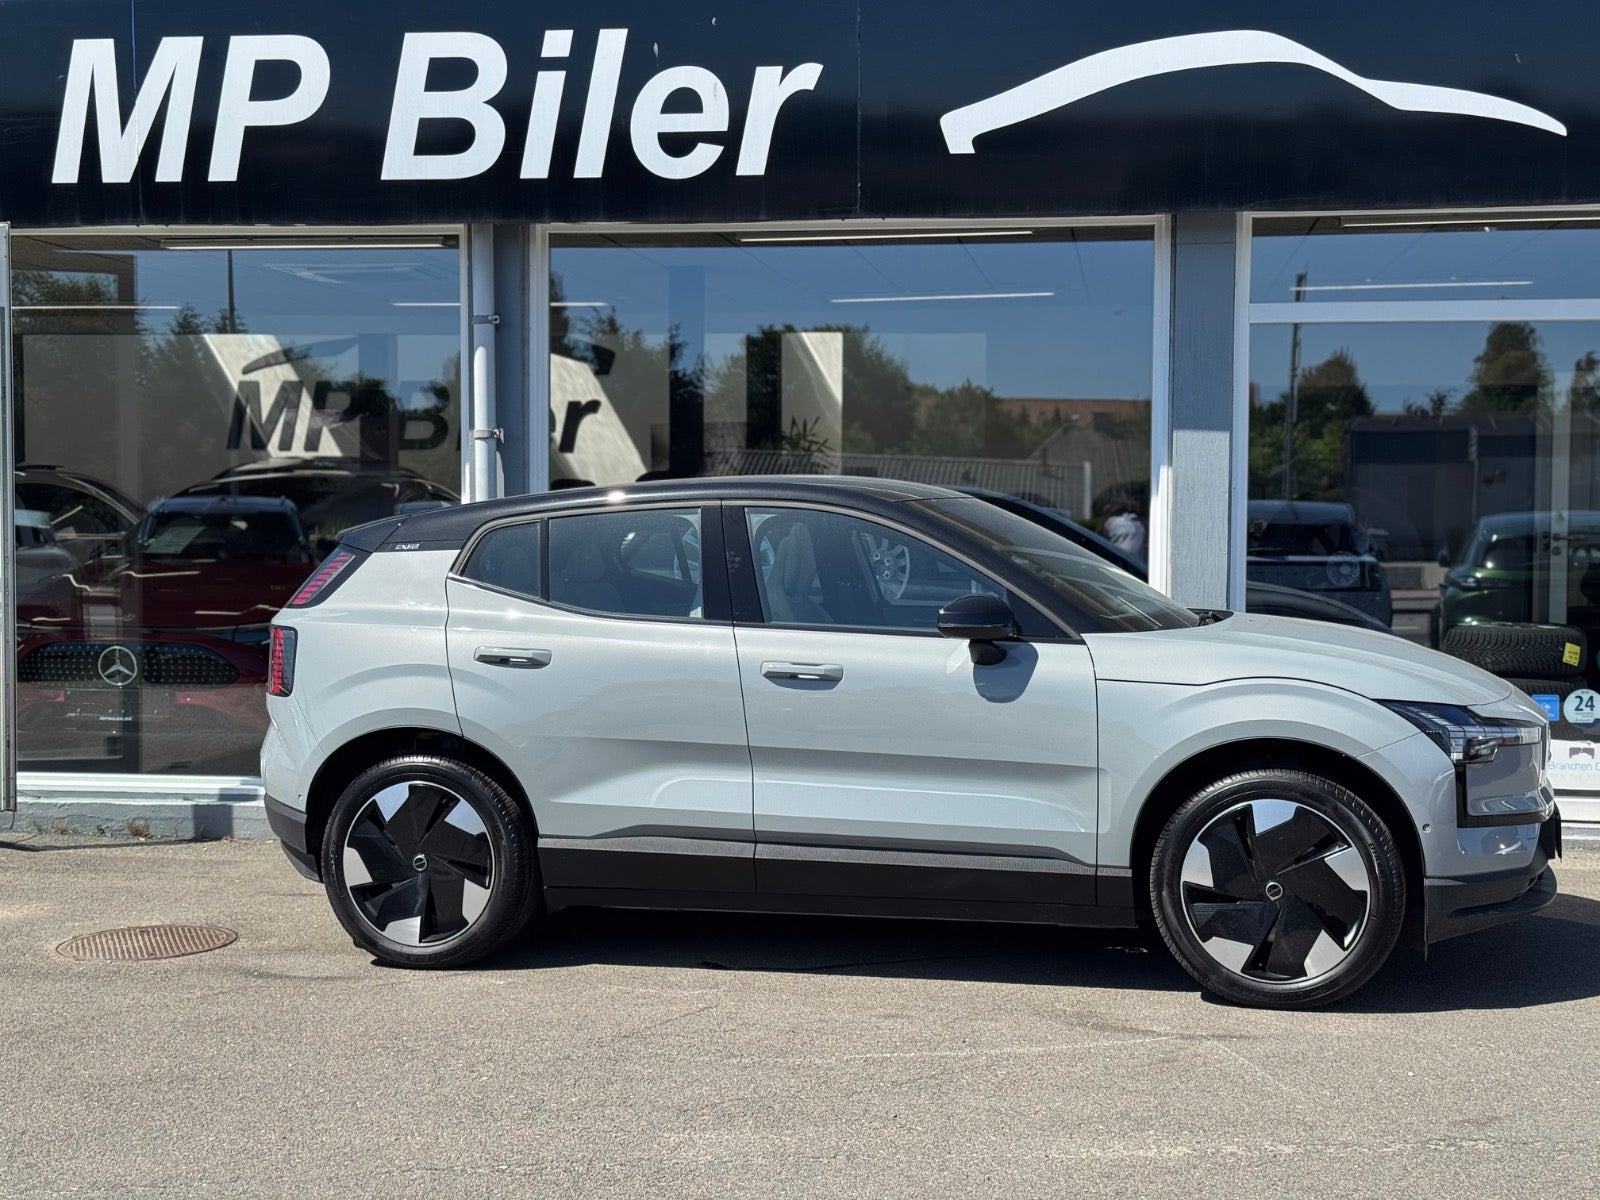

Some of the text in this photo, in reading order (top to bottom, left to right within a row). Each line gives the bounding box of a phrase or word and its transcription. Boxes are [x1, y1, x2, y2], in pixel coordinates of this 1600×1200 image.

[52, 29, 823, 183] MP Biler
[226, 381, 352, 452] MP
[1574, 695, 1595, 712] 24
